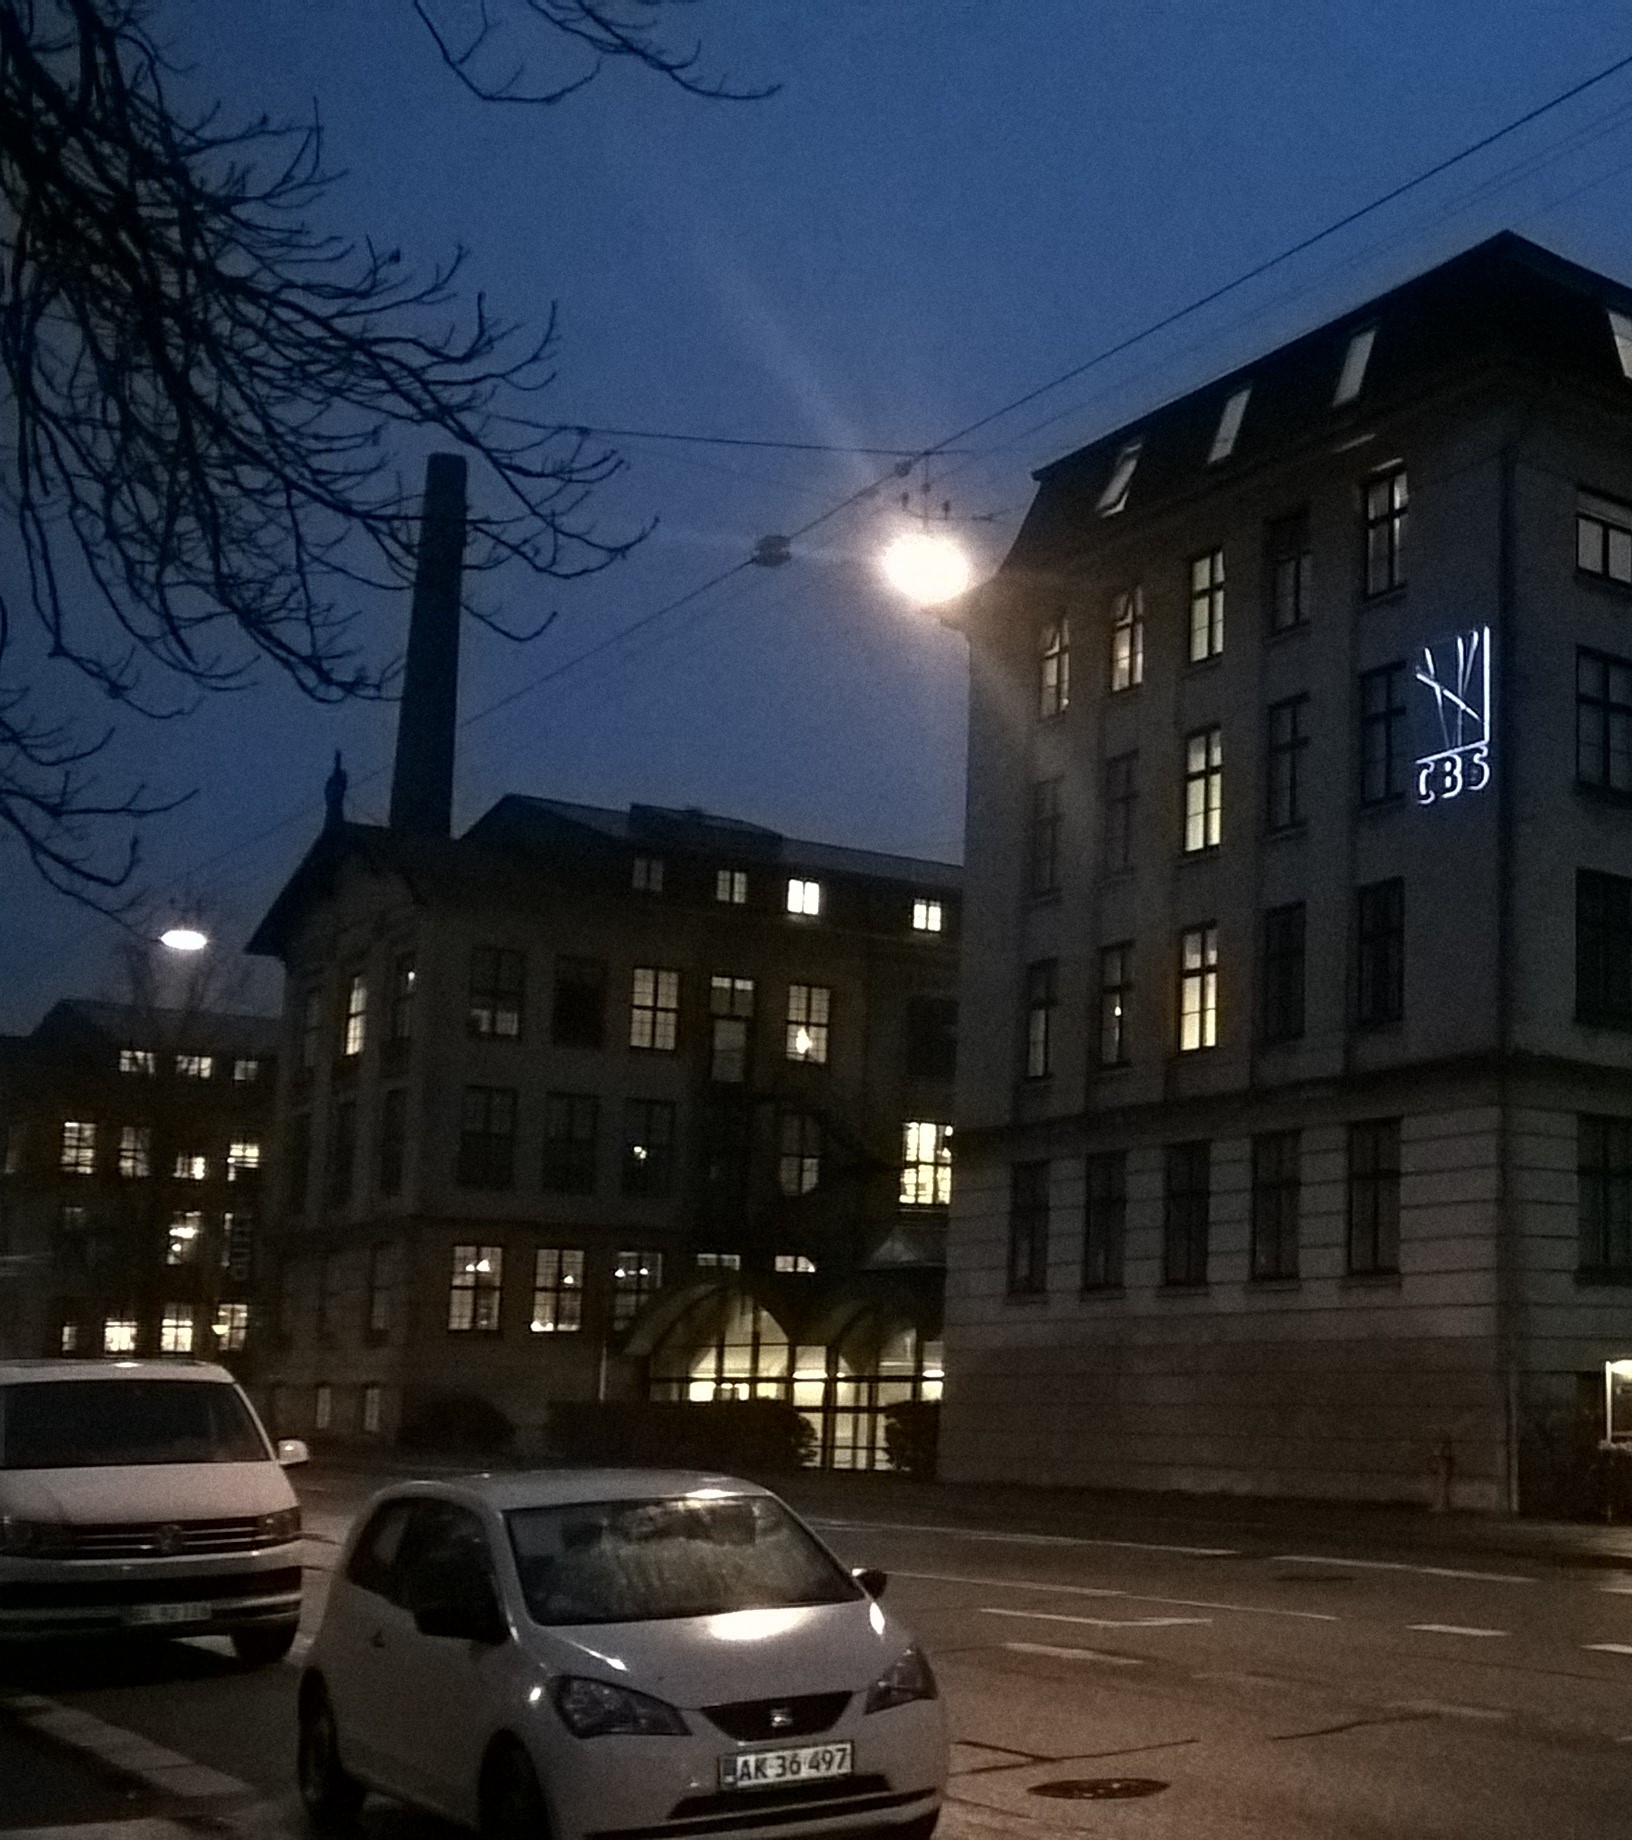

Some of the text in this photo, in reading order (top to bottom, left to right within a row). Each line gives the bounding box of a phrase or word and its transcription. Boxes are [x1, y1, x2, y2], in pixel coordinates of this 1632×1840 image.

[1419, 746, 1490, 804] CBS
[739, 1747, 848, 1781] AK 36 497
